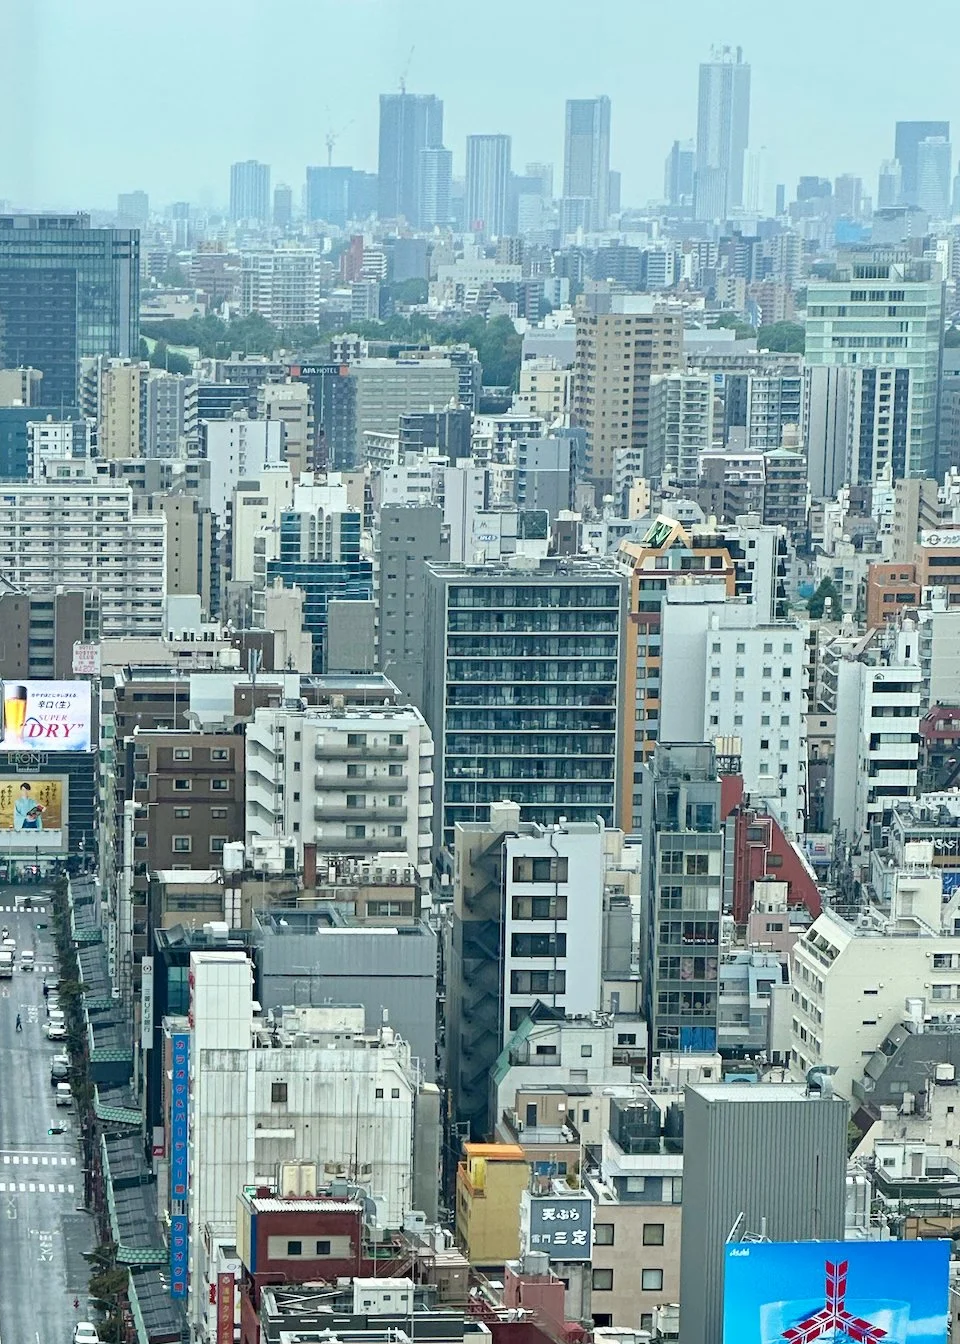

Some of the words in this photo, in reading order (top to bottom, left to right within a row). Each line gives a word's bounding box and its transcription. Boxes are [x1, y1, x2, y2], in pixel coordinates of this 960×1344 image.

[541, 1207, 580, 1221] 天ぷら
[553, 1229, 587, 1246] 三定
